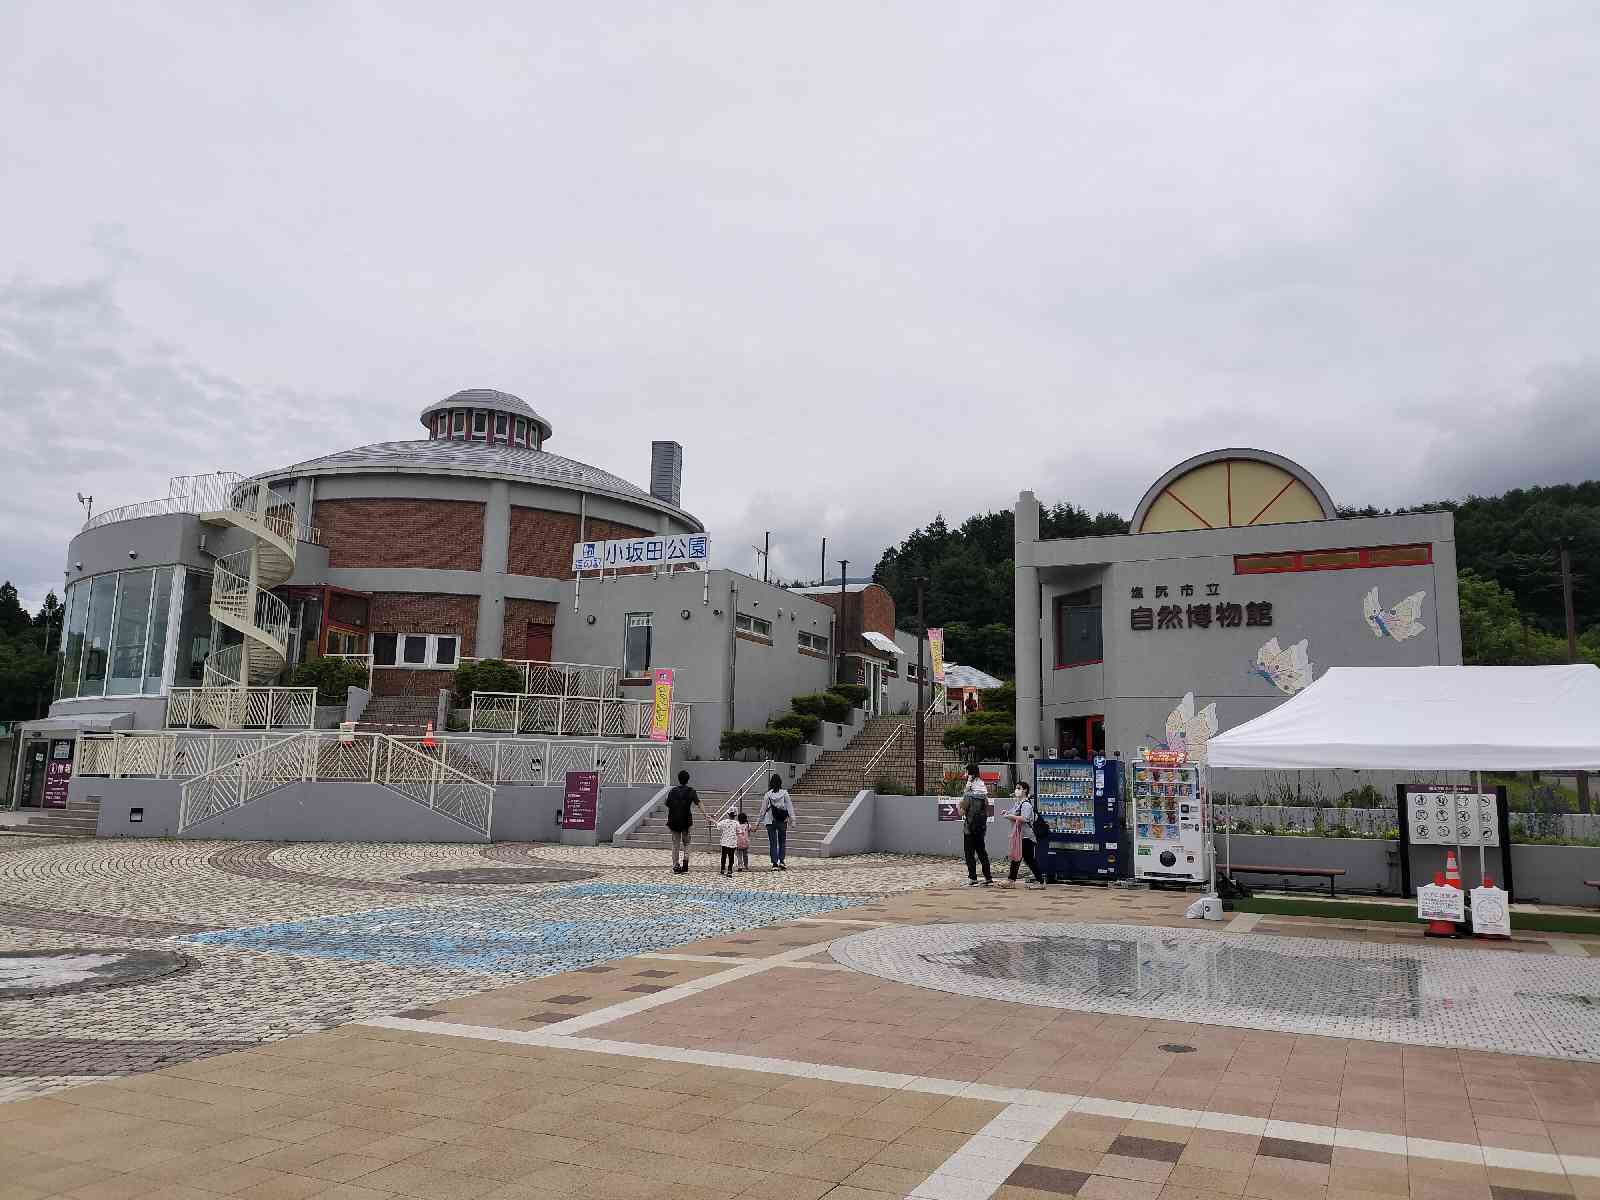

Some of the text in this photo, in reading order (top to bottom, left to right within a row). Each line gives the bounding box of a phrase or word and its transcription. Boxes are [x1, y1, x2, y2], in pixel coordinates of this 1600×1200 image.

[606, 537, 707, 564] 小坂田公園
[1131, 601, 1273, 631] 自然博物館
